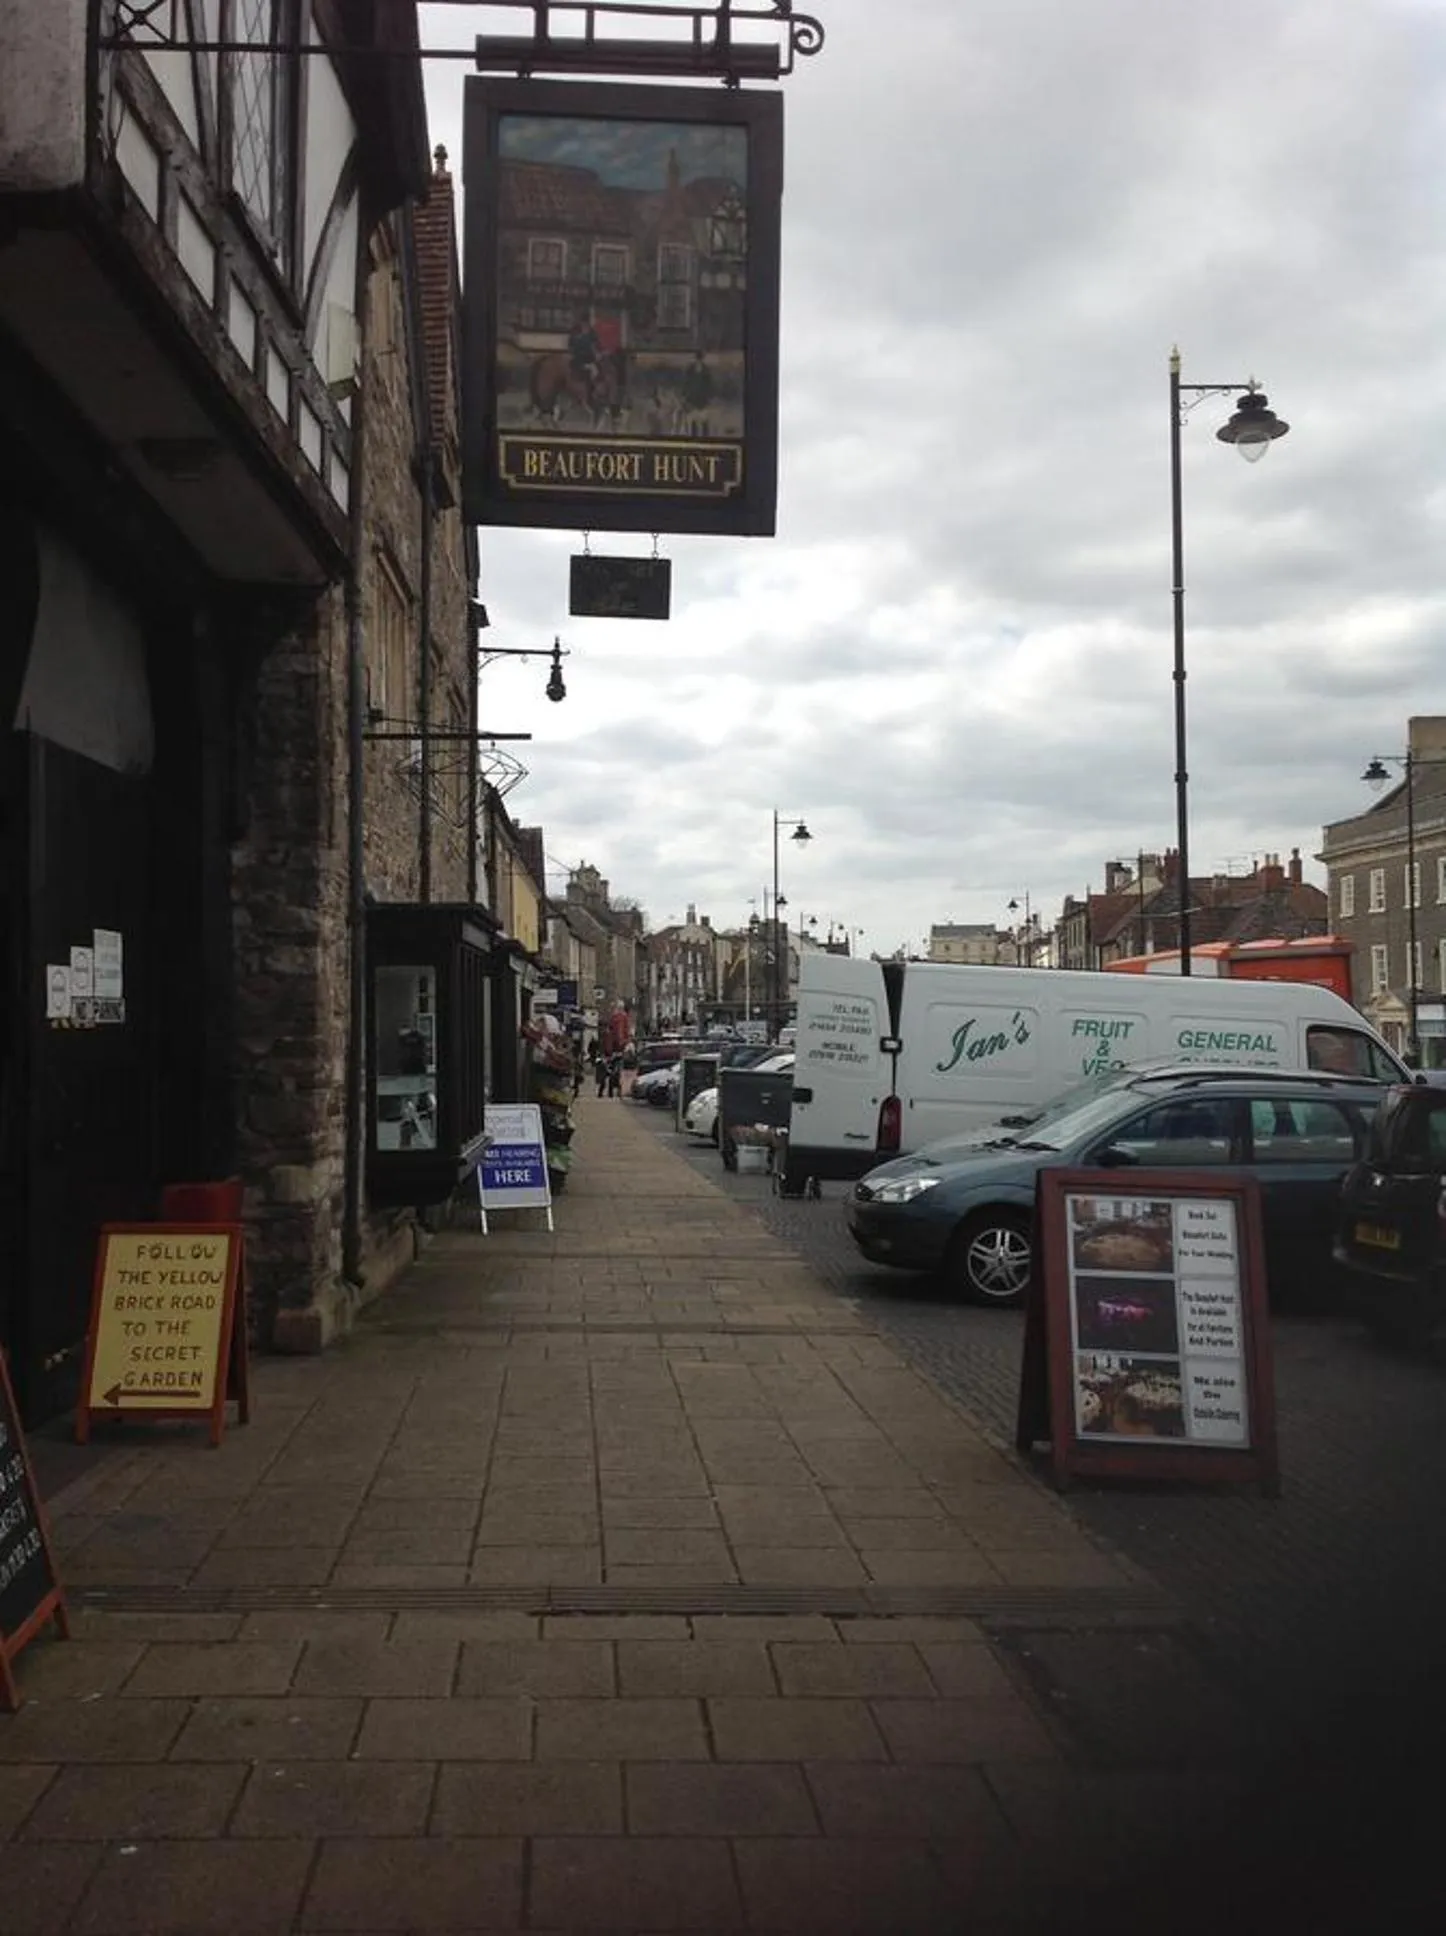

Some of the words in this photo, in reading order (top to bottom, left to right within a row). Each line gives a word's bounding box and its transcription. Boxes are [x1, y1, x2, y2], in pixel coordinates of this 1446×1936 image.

[523, 448, 643, 481] BEAUFORT
[653, 453, 720, 483] HUNT
[1071, 1018, 1135, 1040] FRUIT
[935, 1010, 1030, 1073] Jan's
[1096, 1040, 1110, 1057] &
[1177, 1029, 1278, 1053] GENERAL
[494, 1169, 532, 1184] HERE
[136, 1244, 217, 1260] FOLLOW
[118, 1271, 152, 1285] THE
[157, 1270, 223, 1285] YELLOW
[114, 1296, 163, 1311] BRICK
[170, 1294, 216, 1311] ROAD
[121, 1321, 146, 1337] TO
[154, 1319, 192, 1335] THE
[131, 1345, 202, 1362] SECRET
[124, 1370, 204, 1387] GARDEN
